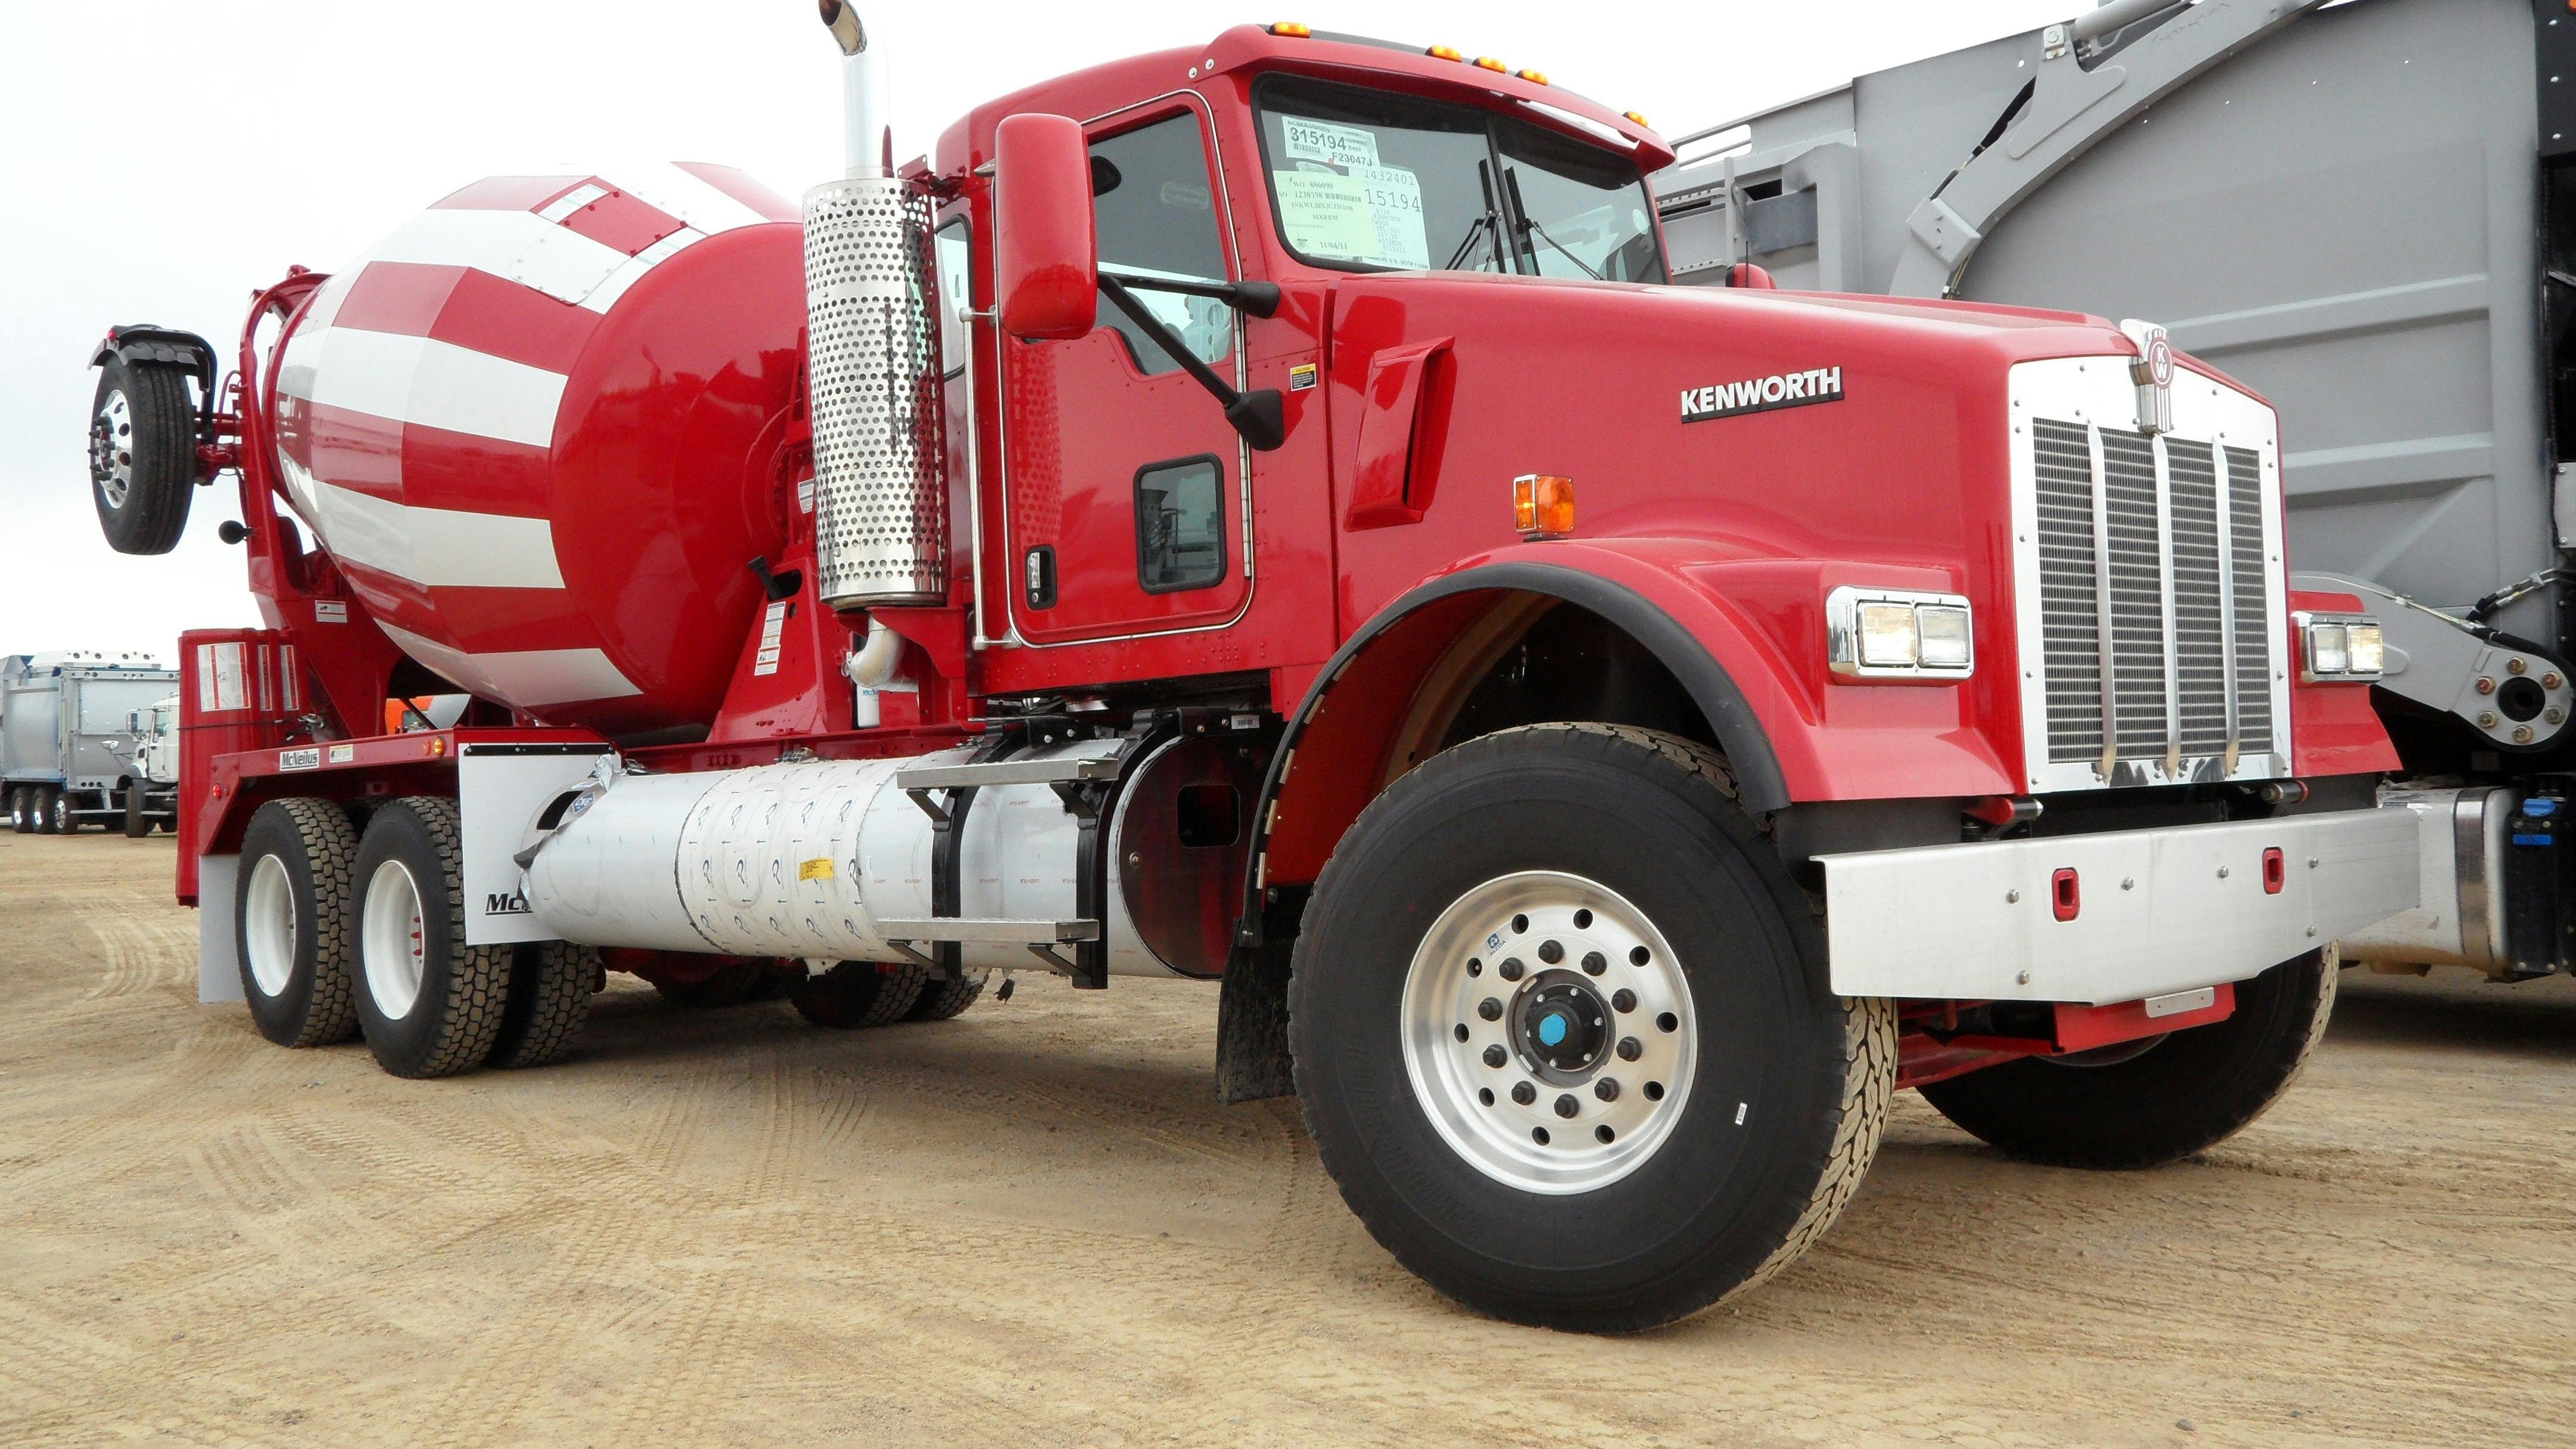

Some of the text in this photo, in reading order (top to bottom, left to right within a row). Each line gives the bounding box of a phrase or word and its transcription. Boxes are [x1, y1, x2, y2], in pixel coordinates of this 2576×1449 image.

[1290, 127, 1346, 150] 315194
[1332, 152, 1372, 166] F23047J
[1365, 170, 1414, 186] 1432401
[1364, 188, 1421, 212] 15194
[1680, 366, 1843, 416] KENWORTH
[282, 751, 318, 766] McNeilus
